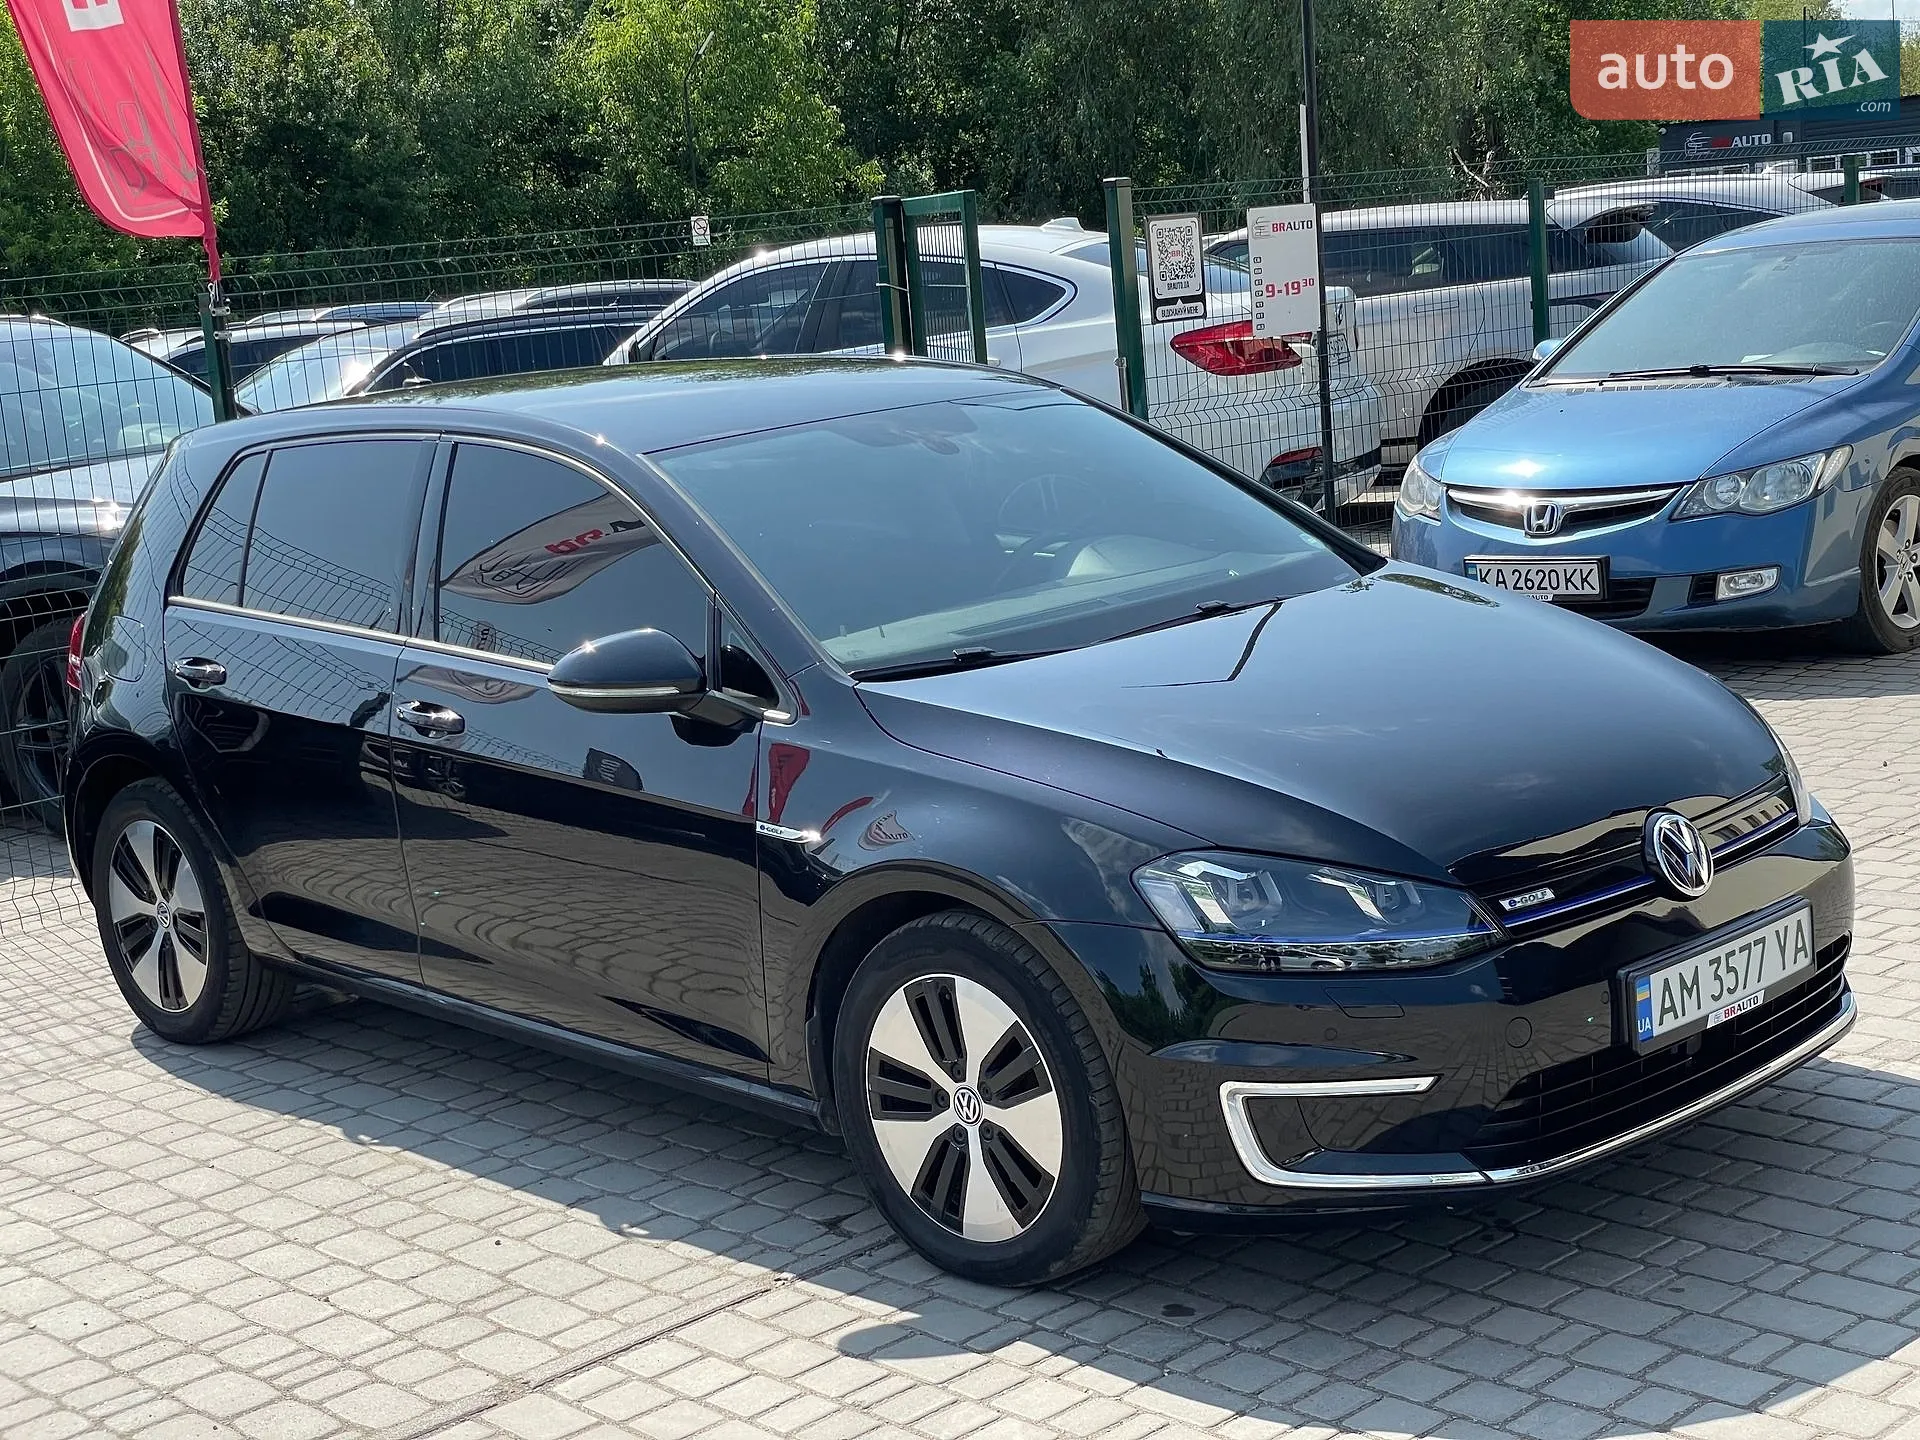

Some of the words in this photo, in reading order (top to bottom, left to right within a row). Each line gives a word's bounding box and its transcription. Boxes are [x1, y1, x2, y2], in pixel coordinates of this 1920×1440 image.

[1271, 219, 1313, 233] BRAUTO
[1511, 568, 1560, 591] 2620
[1563, 568, 1597, 591] KK
[1508, 890, 1548, 907] e-GOLF
[1658, 965, 1702, 1027] AM
[1708, 936, 1767, 1002] 3577
[1775, 918, 1809, 971] YA
[1723, 994, 1760, 1020] BRAUTO
[1637, 1018, 1652, 1034] UA
